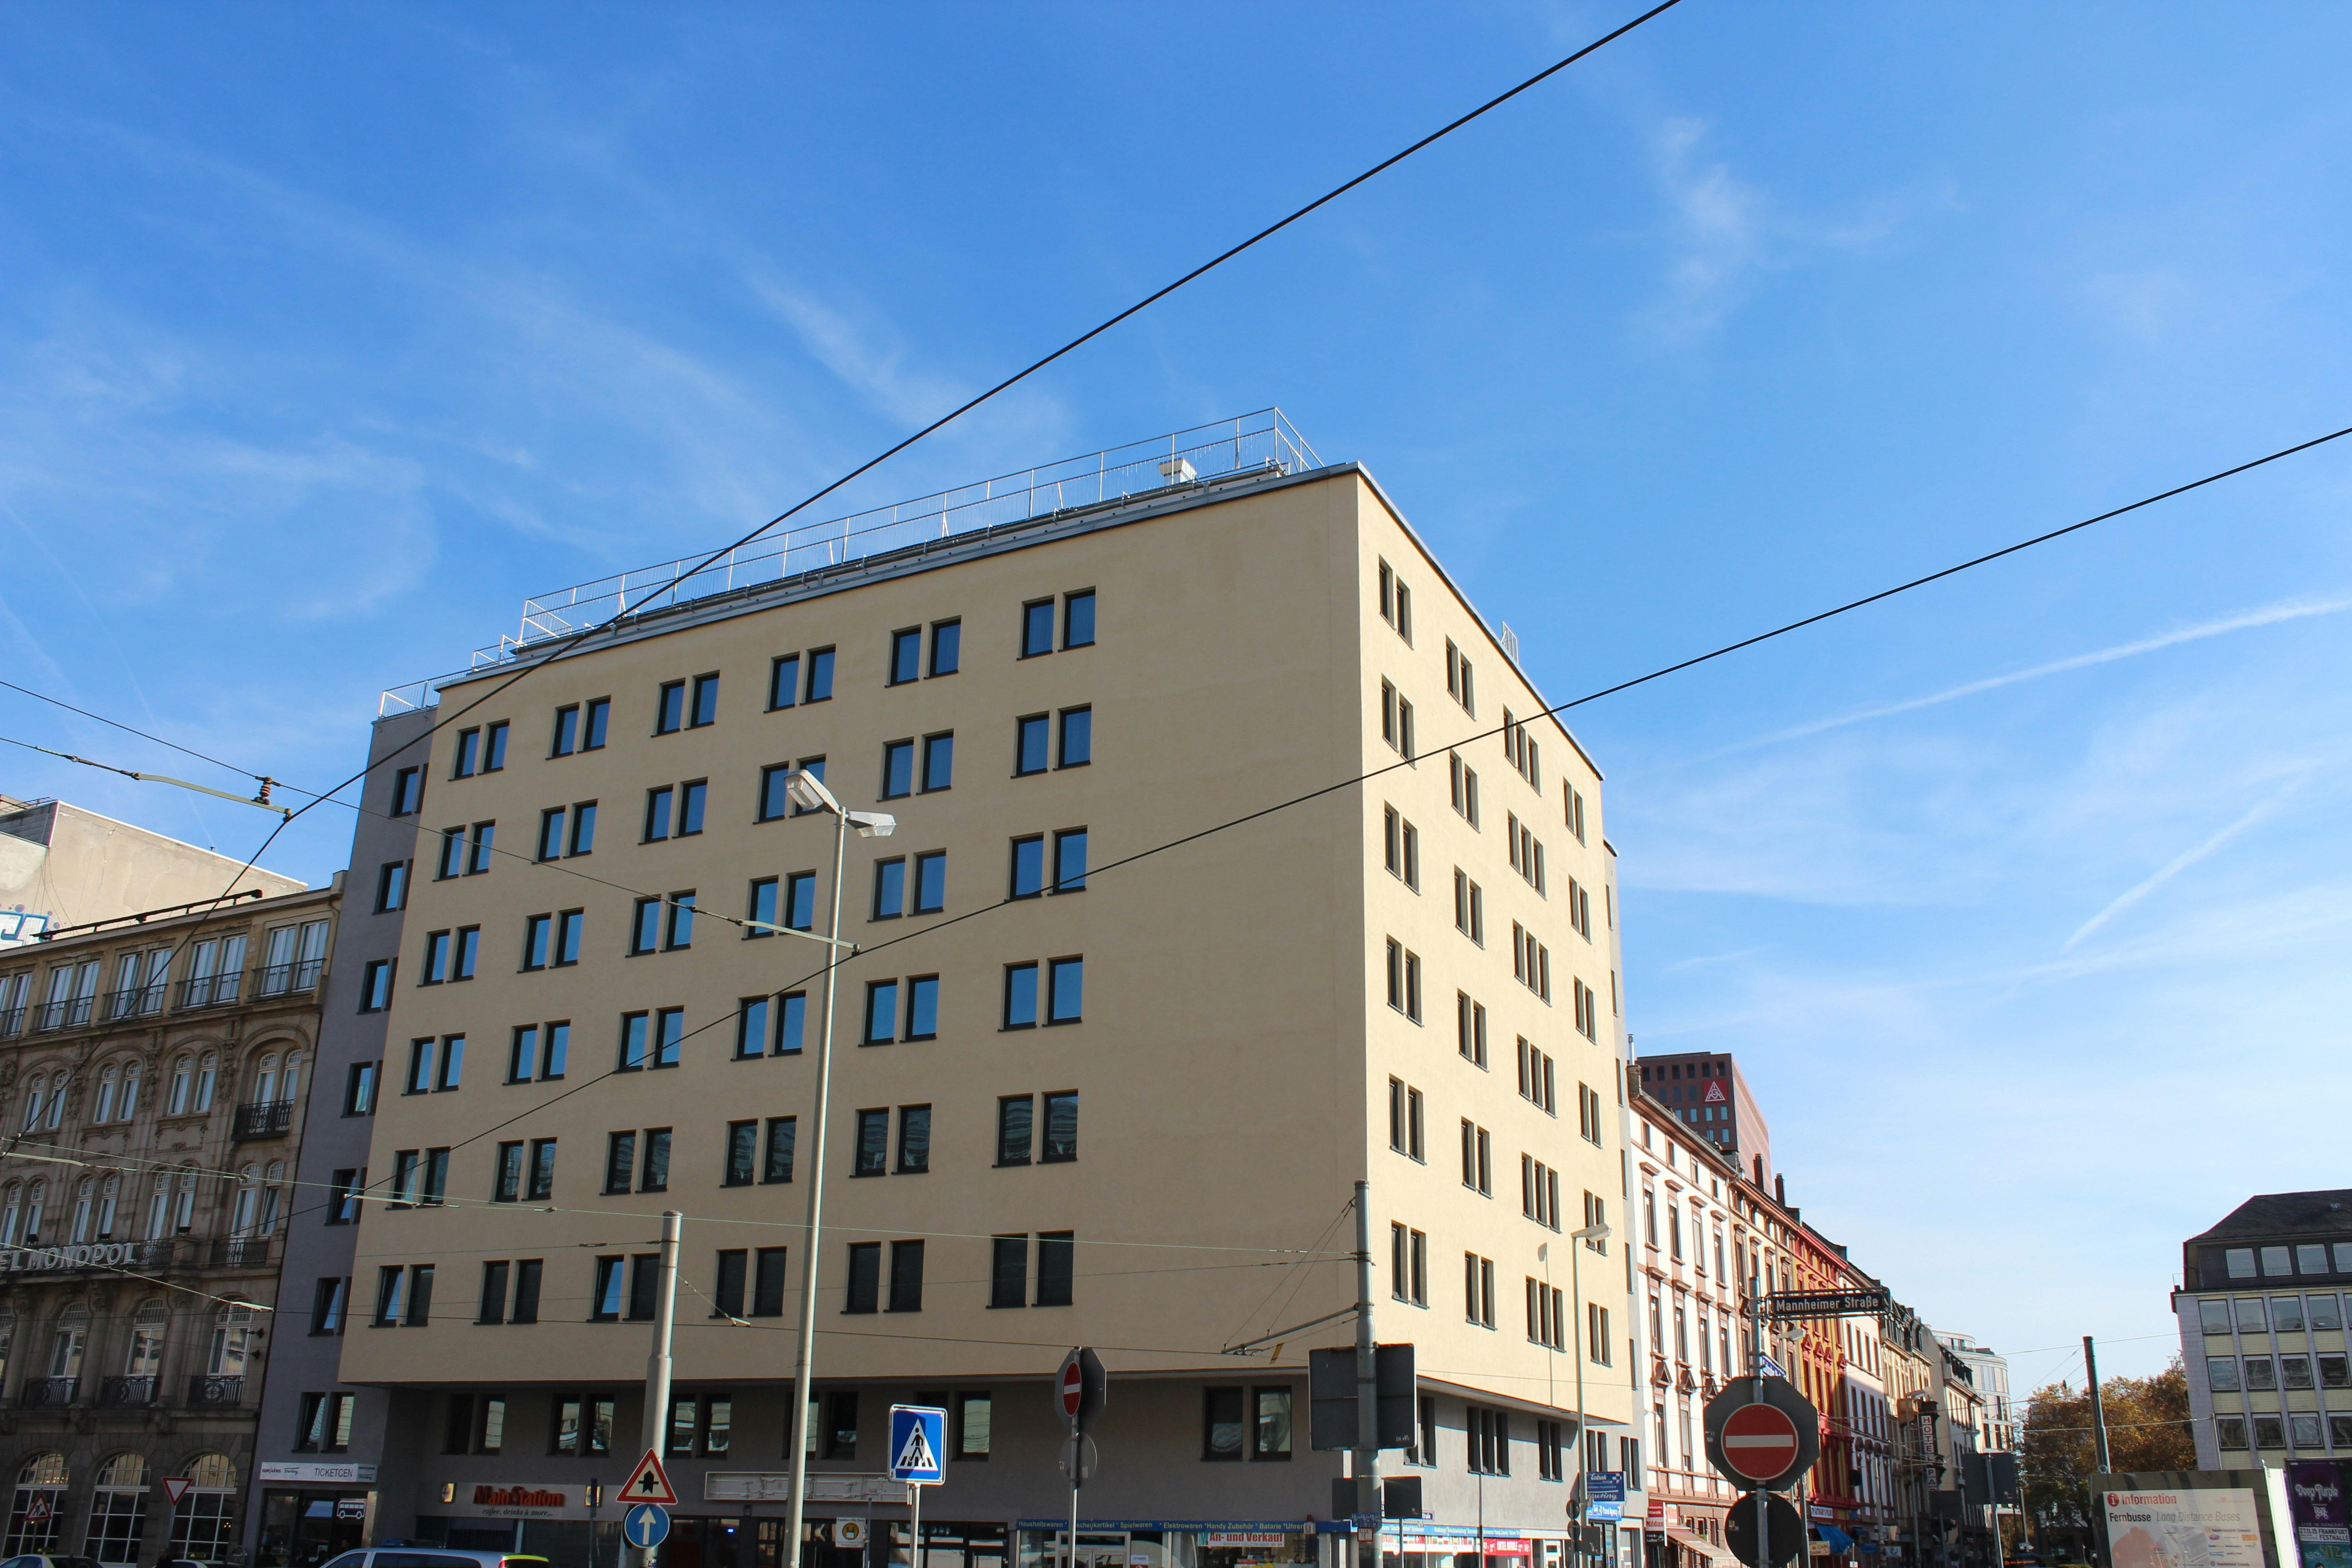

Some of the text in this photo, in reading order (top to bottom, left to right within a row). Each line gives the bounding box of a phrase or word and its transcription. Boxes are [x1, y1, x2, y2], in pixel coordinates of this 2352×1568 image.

[27, 1243, 137, 1269] MONOPOL
[1776, 1295, 1879, 1312] Mannheimer Straße
[1923, 1417, 1933, 1461] HOTEL
[314, 1467, 354, 1477] TICKETCEN
[2295, 1481, 2338, 1502] Deep Purple
[2122, 1494, 2177, 1505] Information
[482, 1507, 502, 1516] coffee,
[503, 1507, 523, 1515] drinks
[2109, 1511, 2240, 1523] Fernbusse Long Distance Buses
[1209, 1533, 1284, 1542] An- und Verkauf
